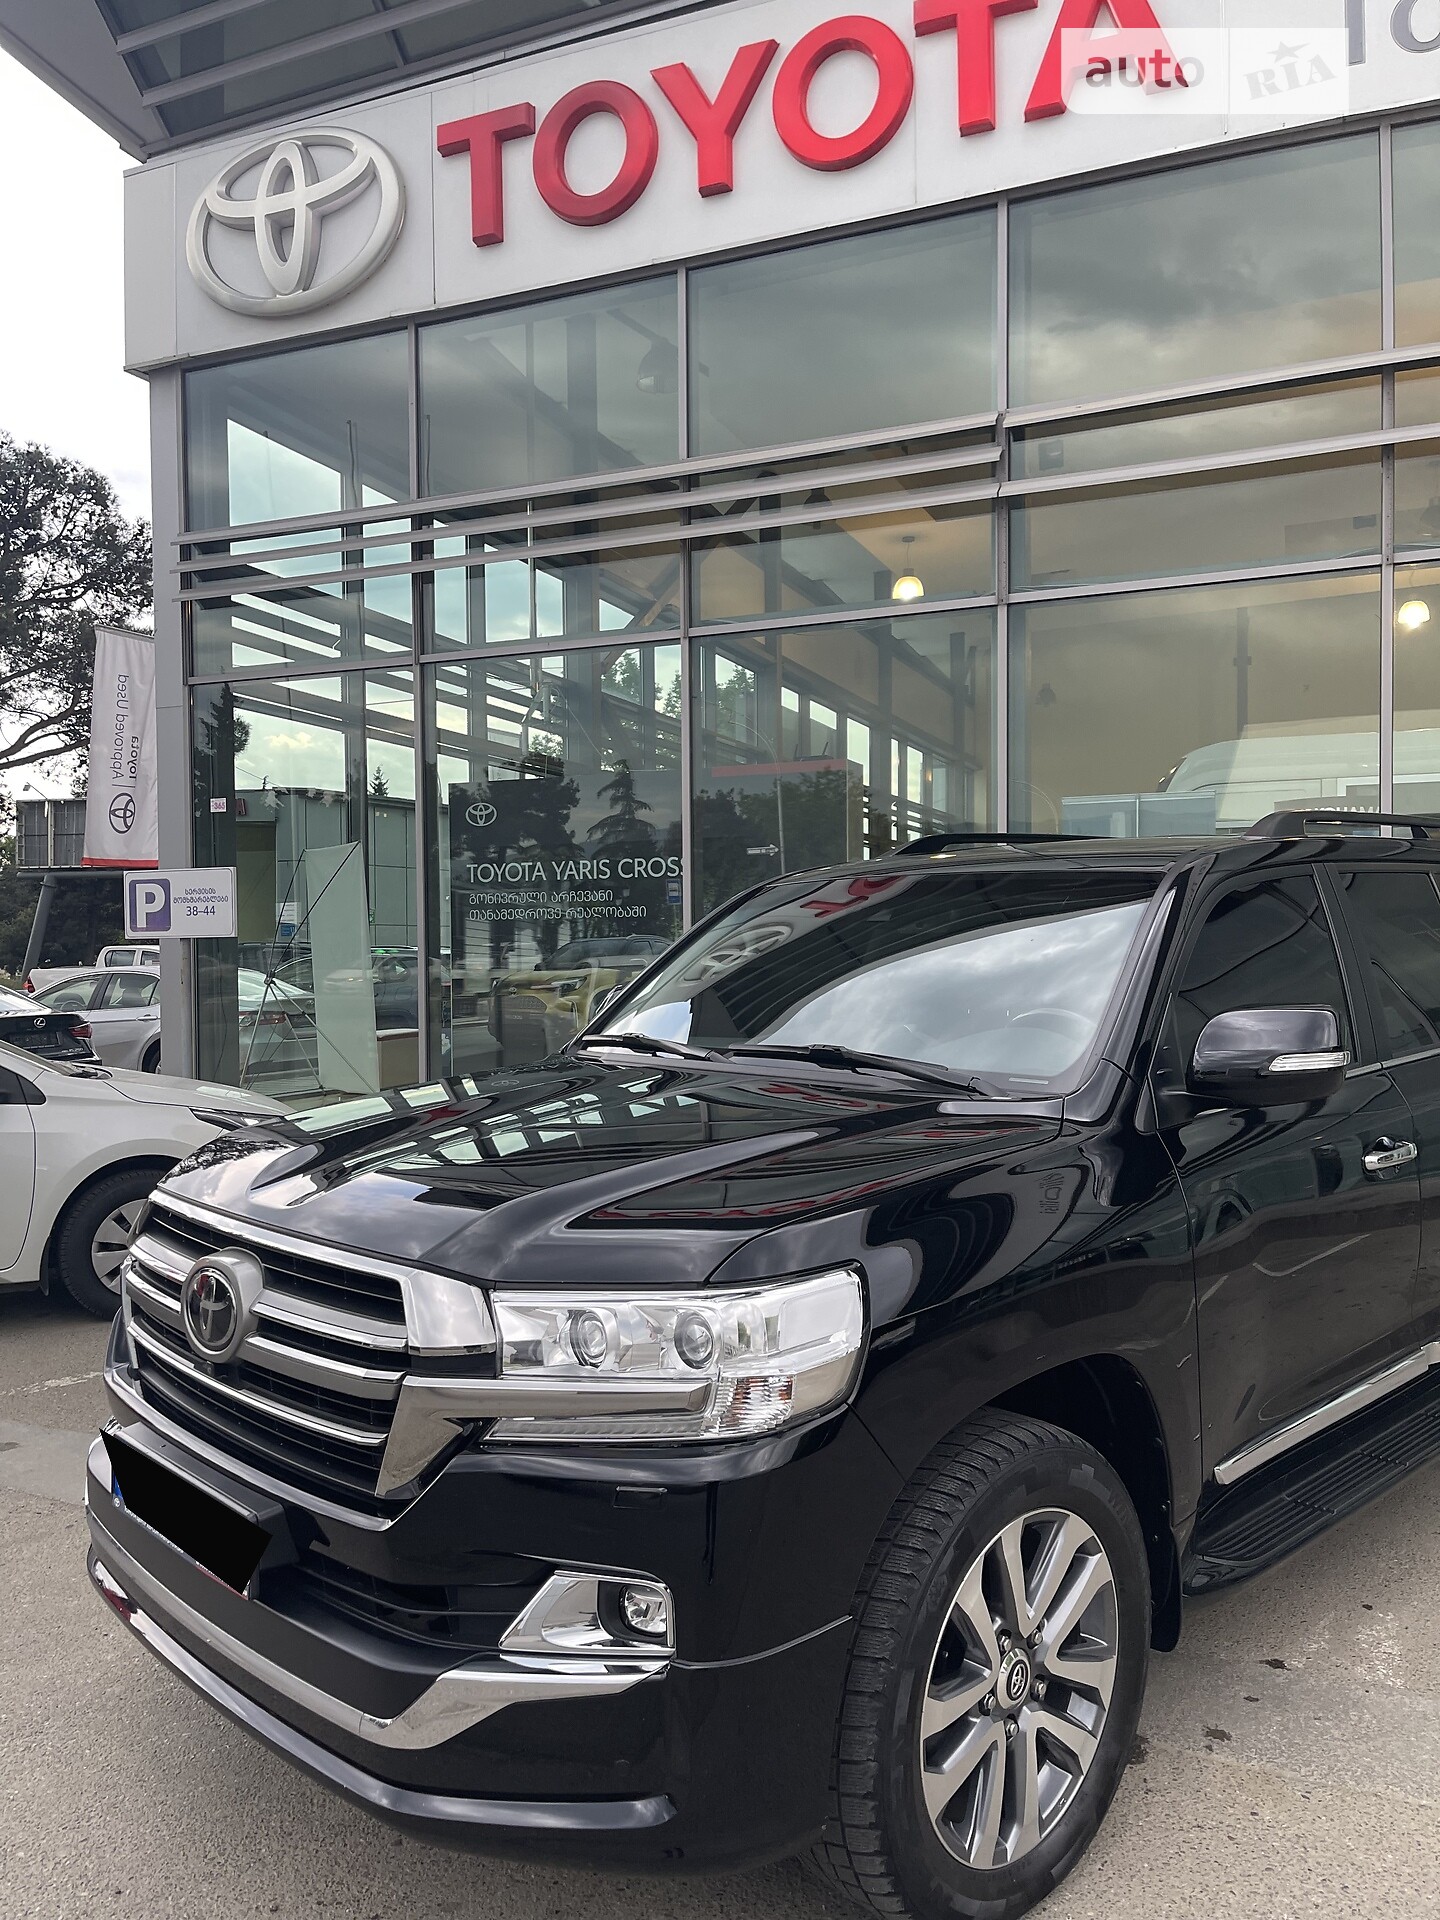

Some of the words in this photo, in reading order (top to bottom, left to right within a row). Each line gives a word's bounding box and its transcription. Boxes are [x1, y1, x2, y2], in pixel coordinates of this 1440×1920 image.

[437, 0, 1190, 247] TOYOTA
[466, 861, 547, 883] TOYOTA
[551, 858, 611, 880] YARIS
[136, 883, 166, 928] P
[469, 891, 547, 905] გონივრული
[550, 889, 613, 903] არჩევანი
[469, 908, 562, 920] თანამედროვე
[565, 905, 647, 918] რეალობაში
